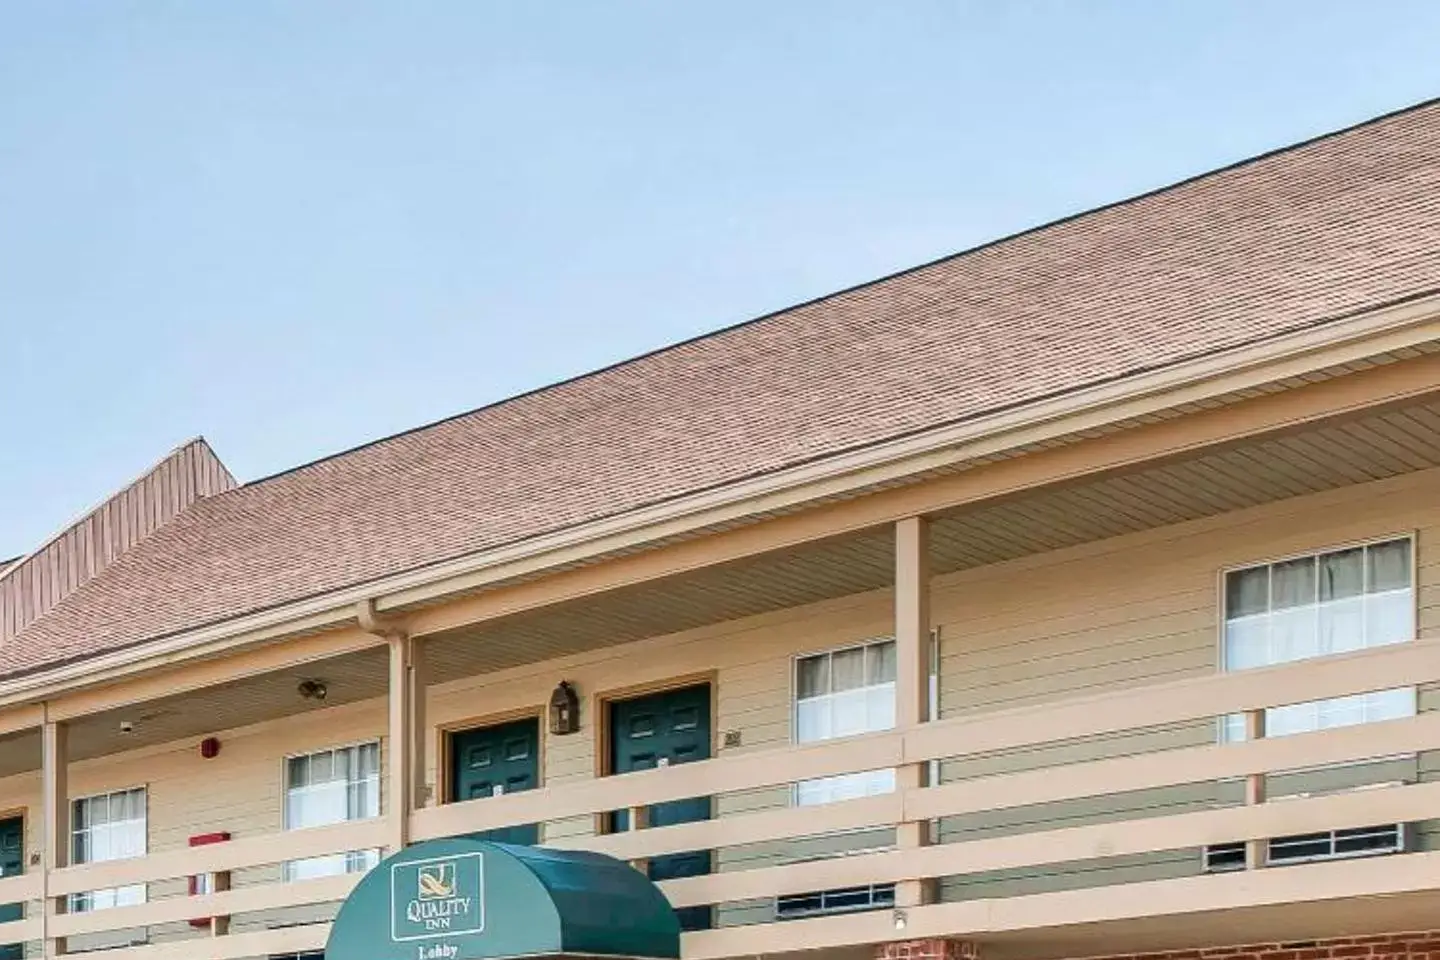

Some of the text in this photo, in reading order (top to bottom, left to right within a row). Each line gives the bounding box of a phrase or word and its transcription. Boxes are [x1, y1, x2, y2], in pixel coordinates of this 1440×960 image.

[406, 897, 471, 922] QUALITY
[426, 917, 451, 930] INN
[418, 943, 458, 960] Lobby
